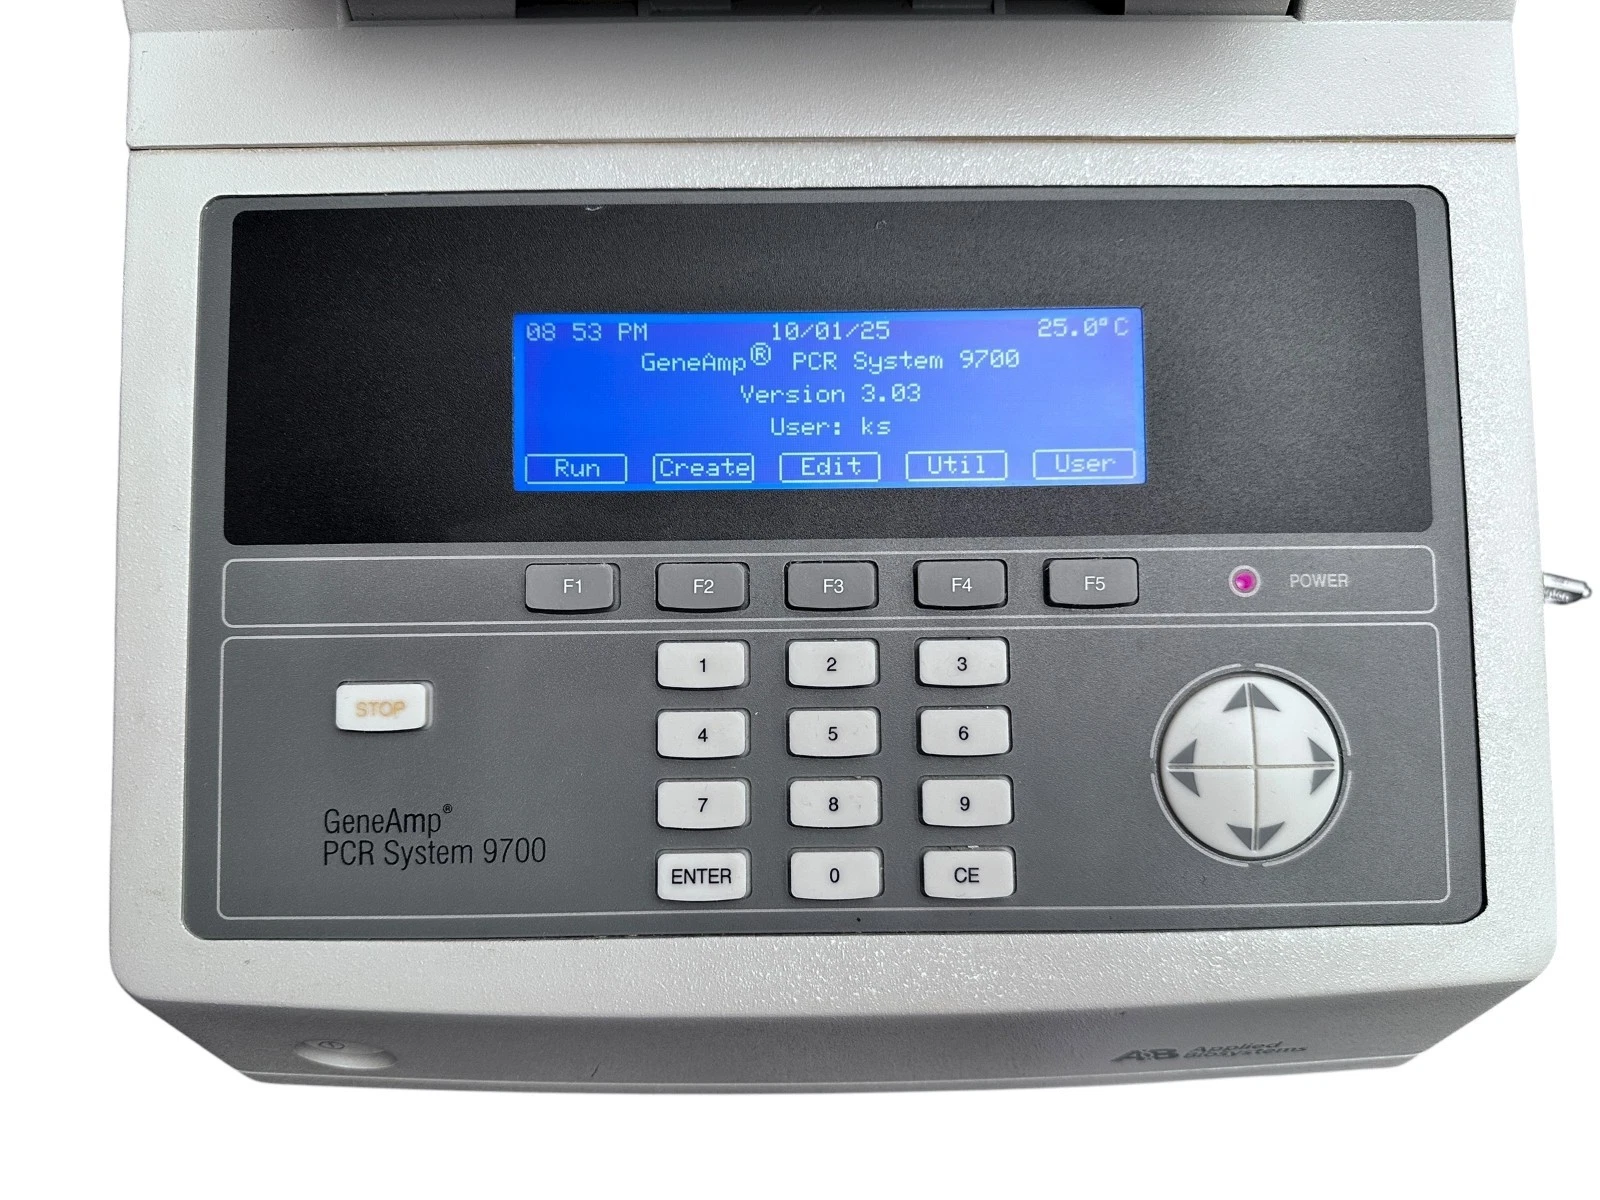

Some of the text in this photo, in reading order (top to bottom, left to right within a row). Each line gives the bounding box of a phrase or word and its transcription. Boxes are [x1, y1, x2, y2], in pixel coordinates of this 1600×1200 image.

[526, 322, 648, 342] 08 53 PM
[772, 321, 890, 341] 10/01/25
[792, 351, 838, 371] PCR
[853, 350, 943, 375] System
[959, 348, 1020, 369] 9700
[740, 383, 921, 404] Version 3.03
[770, 416, 891, 436] User: ks
[555, 458, 601, 478] Run
[659, 457, 751, 478] Create
[800, 456, 862, 477] Edit
[927, 454, 986, 475] Util
[1055, 453, 1116, 474] User
[562, 578, 584, 595] F1
[692, 578, 715, 595] F2
[822, 578, 845, 595] F3
[951, 576, 973, 593] F4
[1083, 575, 1106, 592] F5
[1289, 572, 1350, 589] POWER
[699, 657, 708, 673] 1
[825, 656, 838, 673] 2
[956, 655, 968, 673] 3
[354, 701, 407, 718] STOP
[697, 726, 709, 743] 4
[827, 725, 839, 742] 5
[957, 724, 970, 742] 6
[697, 796, 709, 813] 7
[828, 795, 840, 812] 8
[959, 795, 971, 812] 9
[323, 836, 547, 871] PCR System 9700
[671, 868, 733, 885] ENTER
[829, 867, 841, 884] 0
[953, 866, 981, 884] CE
